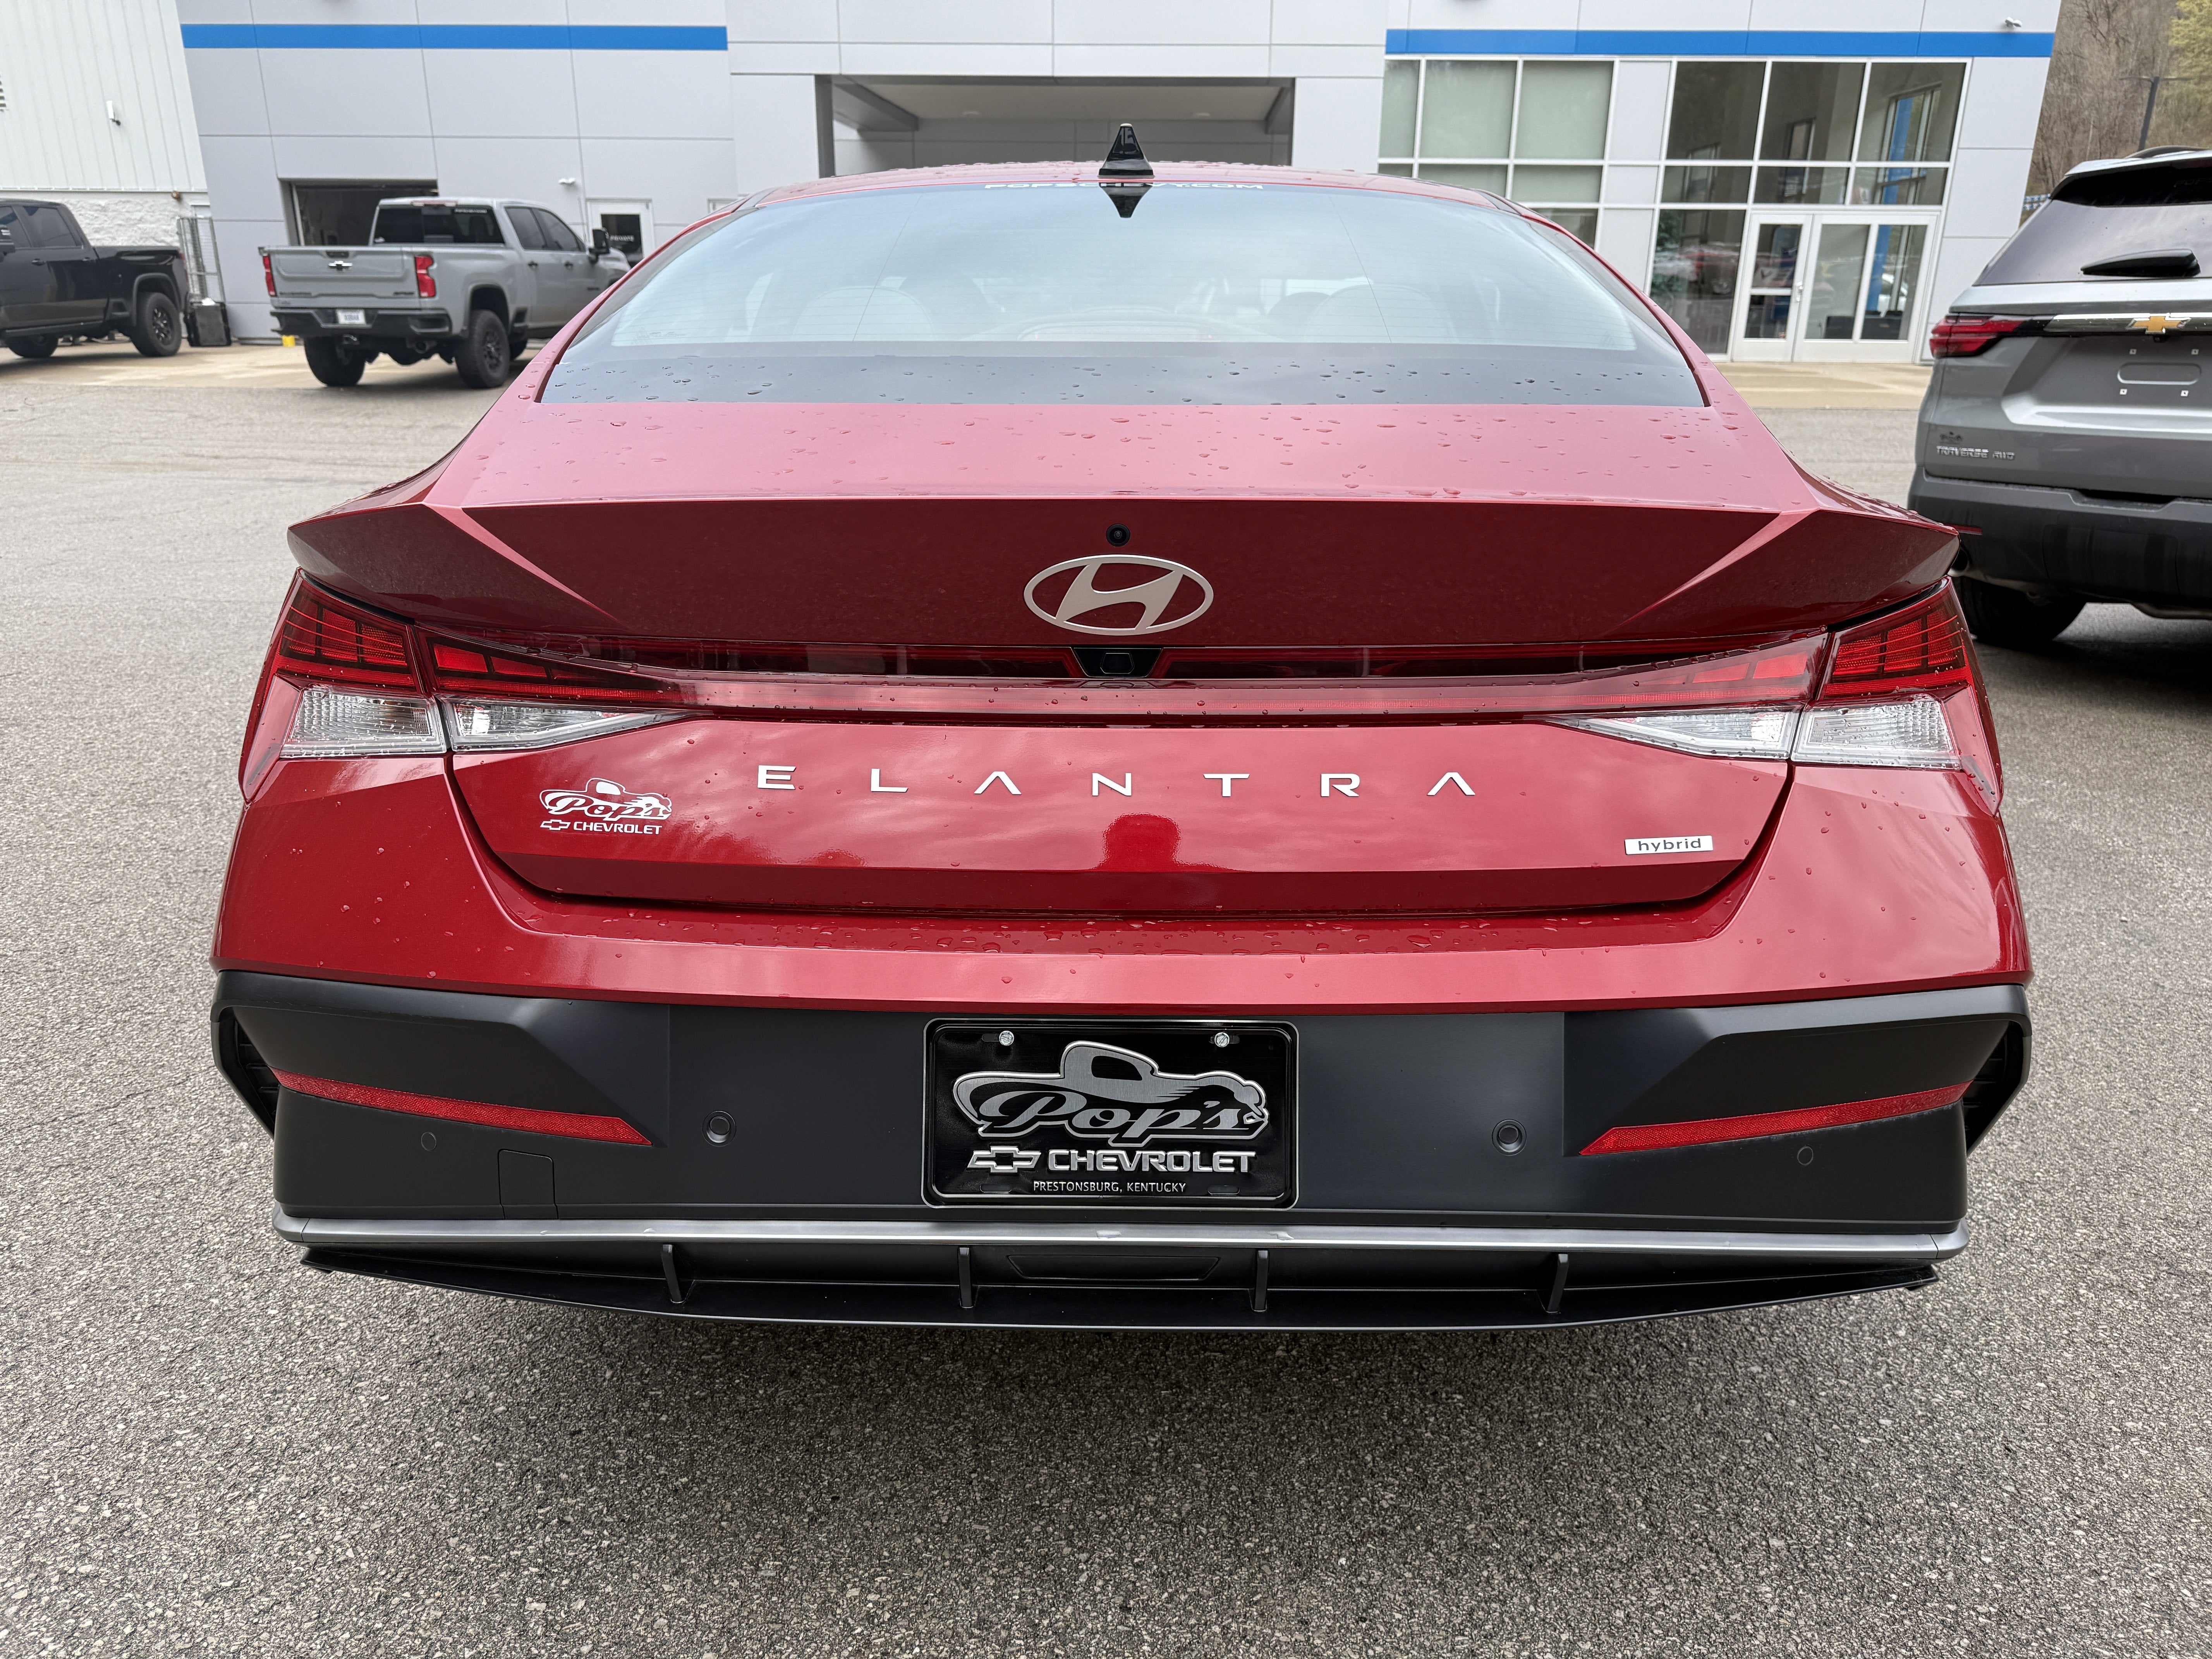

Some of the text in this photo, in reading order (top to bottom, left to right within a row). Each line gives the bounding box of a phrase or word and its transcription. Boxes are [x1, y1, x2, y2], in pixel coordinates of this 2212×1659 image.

[757, 765, 1475, 797] ELANTRA
[574, 821, 663, 835] CHEVROLET
[1638, 838, 1701, 852] hybrid
[979, 1091, 1249, 1138] Pop's
[1048, 1150, 1256, 1173] CHEVROLET
[1034, 1181, 1186, 1193] PRESTONSBURG, KENTUCKY
